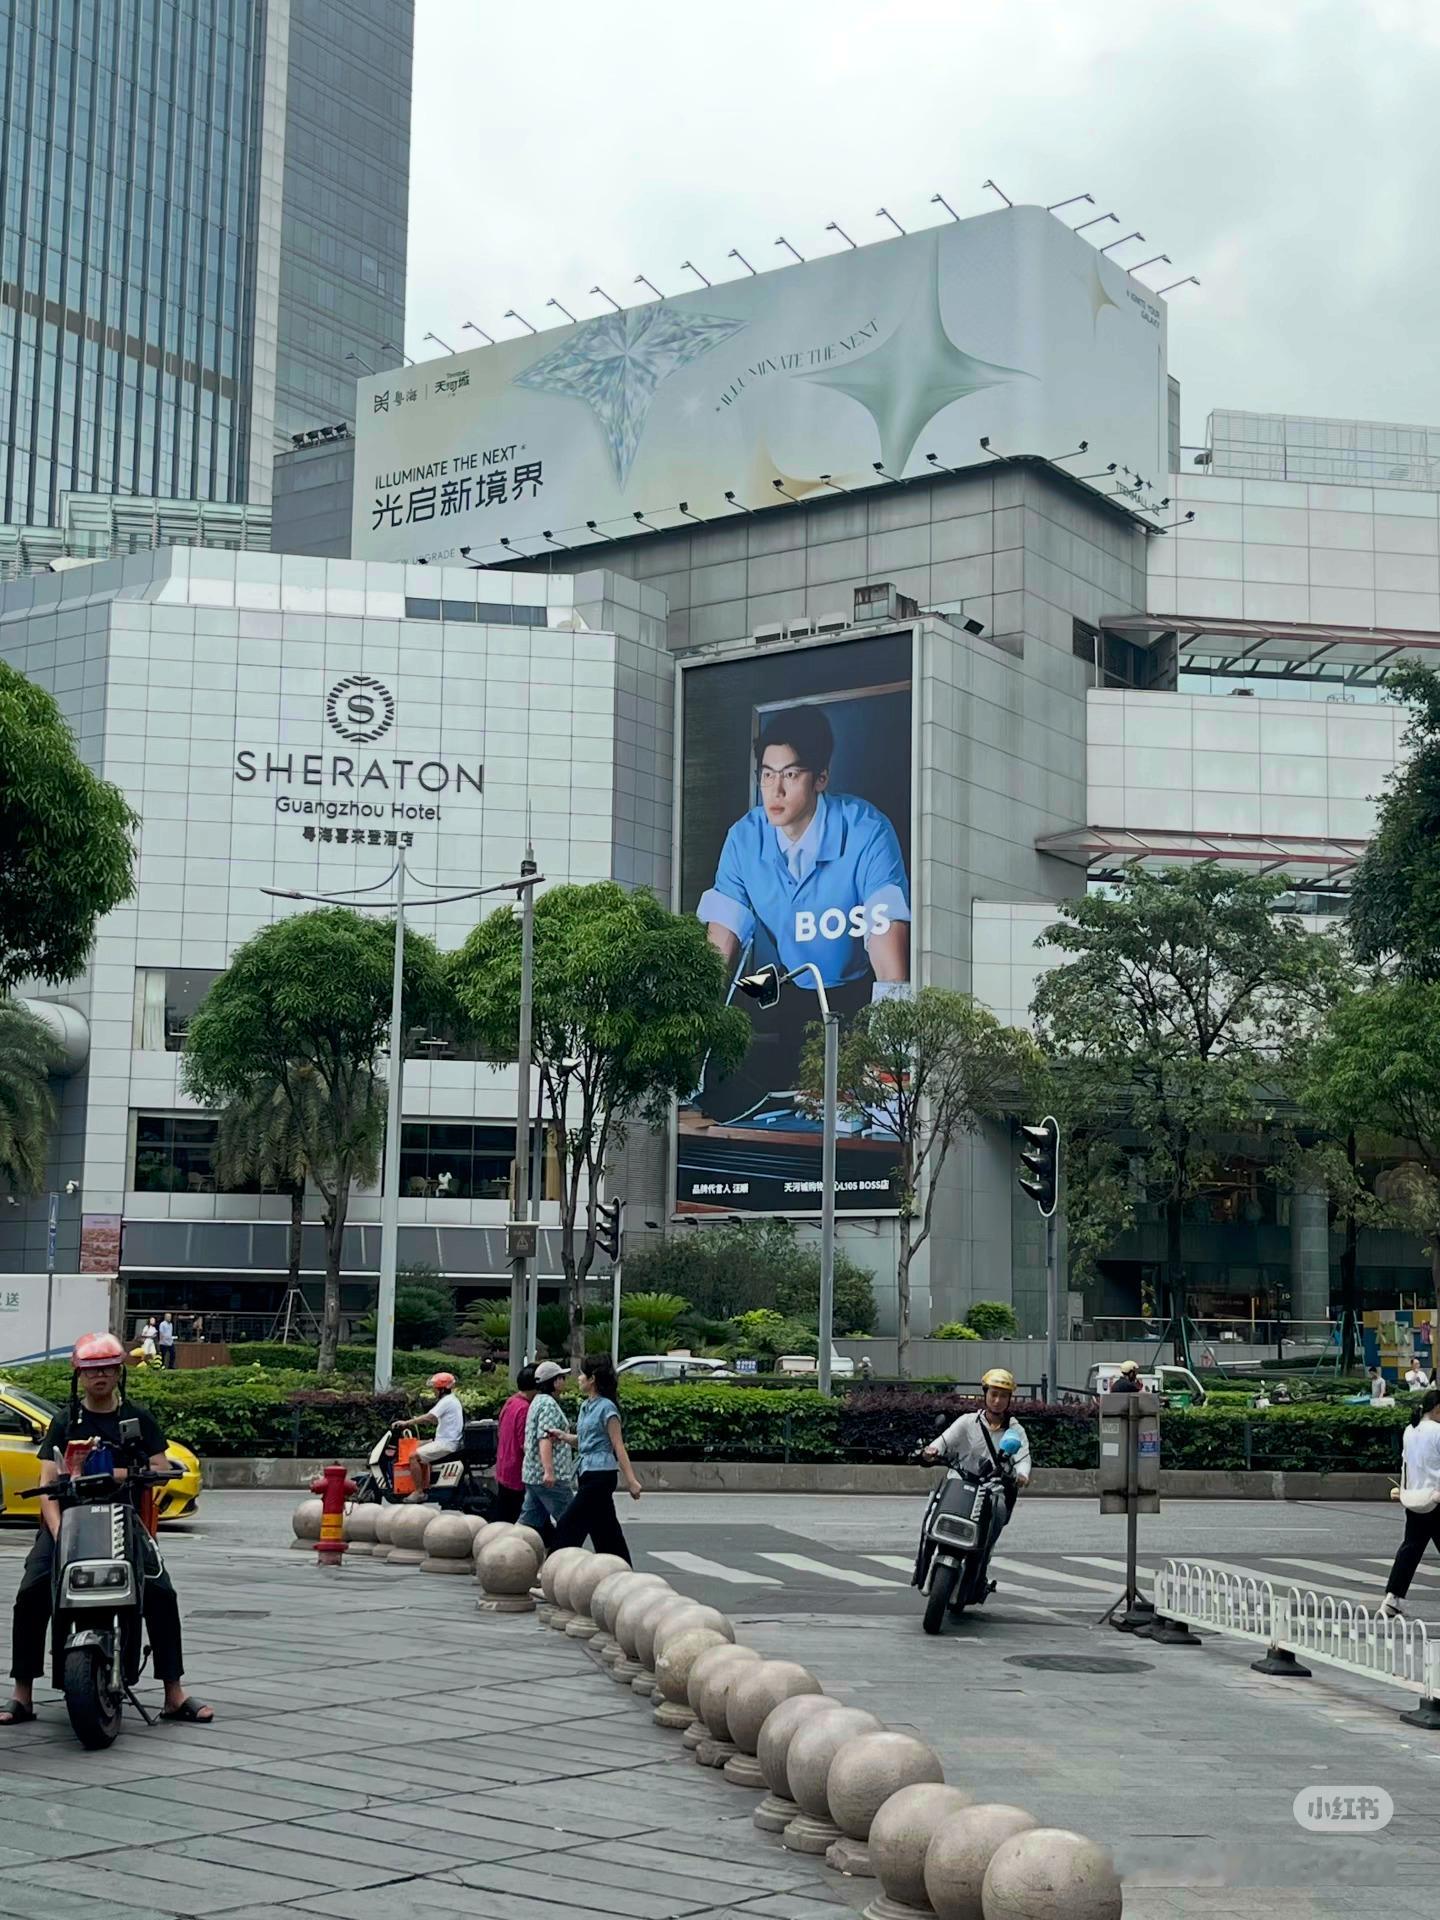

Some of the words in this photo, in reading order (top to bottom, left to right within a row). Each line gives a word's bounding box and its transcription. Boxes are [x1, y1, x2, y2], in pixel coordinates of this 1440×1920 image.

[375, 460, 448, 490] ILLUMINATE
[453, 453, 478, 473] THE
[482, 444, 518, 466] NEXT
[372, 460, 543, 531] 光启新境界
[347, 694, 374, 724] S
[235, 750, 484, 794] SHERATON
[275, 796, 384, 819] Guangzhou
[391, 802, 441, 821] Hotel
[302, 826, 414, 847] 粤海喜来登酒店
[795, 903, 891, 942] BOSS
[0, 1292, 20, 1306] 送
